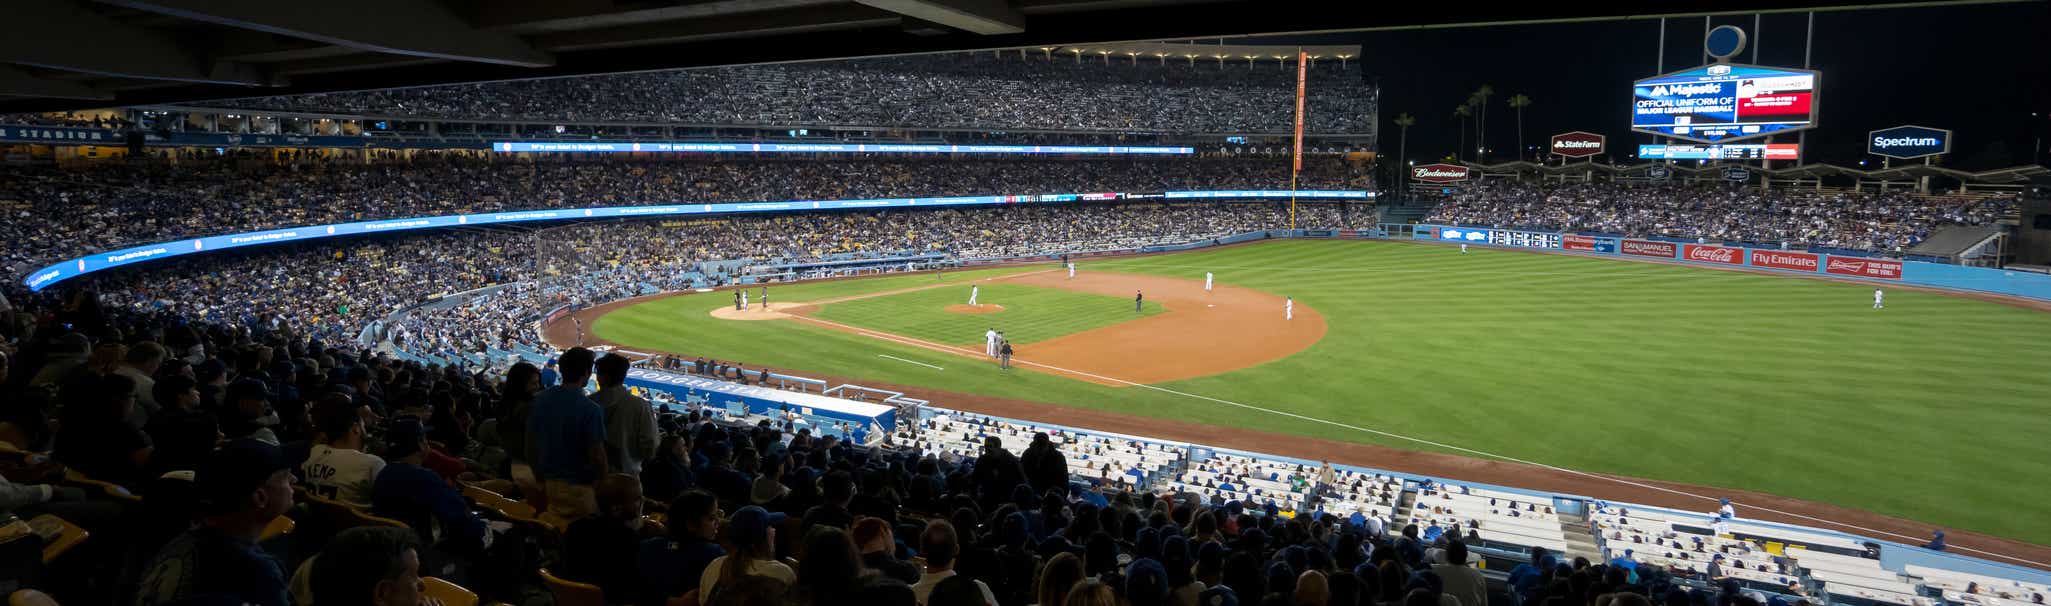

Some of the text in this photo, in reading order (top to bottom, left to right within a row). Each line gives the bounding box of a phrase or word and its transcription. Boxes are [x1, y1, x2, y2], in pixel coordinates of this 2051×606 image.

[1669, 83, 1722, 97] Majestic
[1637, 98, 1674, 108] OFFICIAL
[1675, 97, 1718, 107] UNIFORM
[1719, 96, 1734, 105] OF
[1664, 106, 1693, 114] LEAGUE
[1694, 105, 1733, 113] BASEBALL
[19, 129, 102, 140] STADIUM
[1874, 136, 1936, 149] Spectrum
[1414, 167, 1466, 178] Budweiser
[1623, 242, 1637, 250] SAN
[1642, 243, 1673, 253] MANUEL
[1753, 253, 1817, 267] Fly Emirates
[307, 463, 336, 479] EMP
